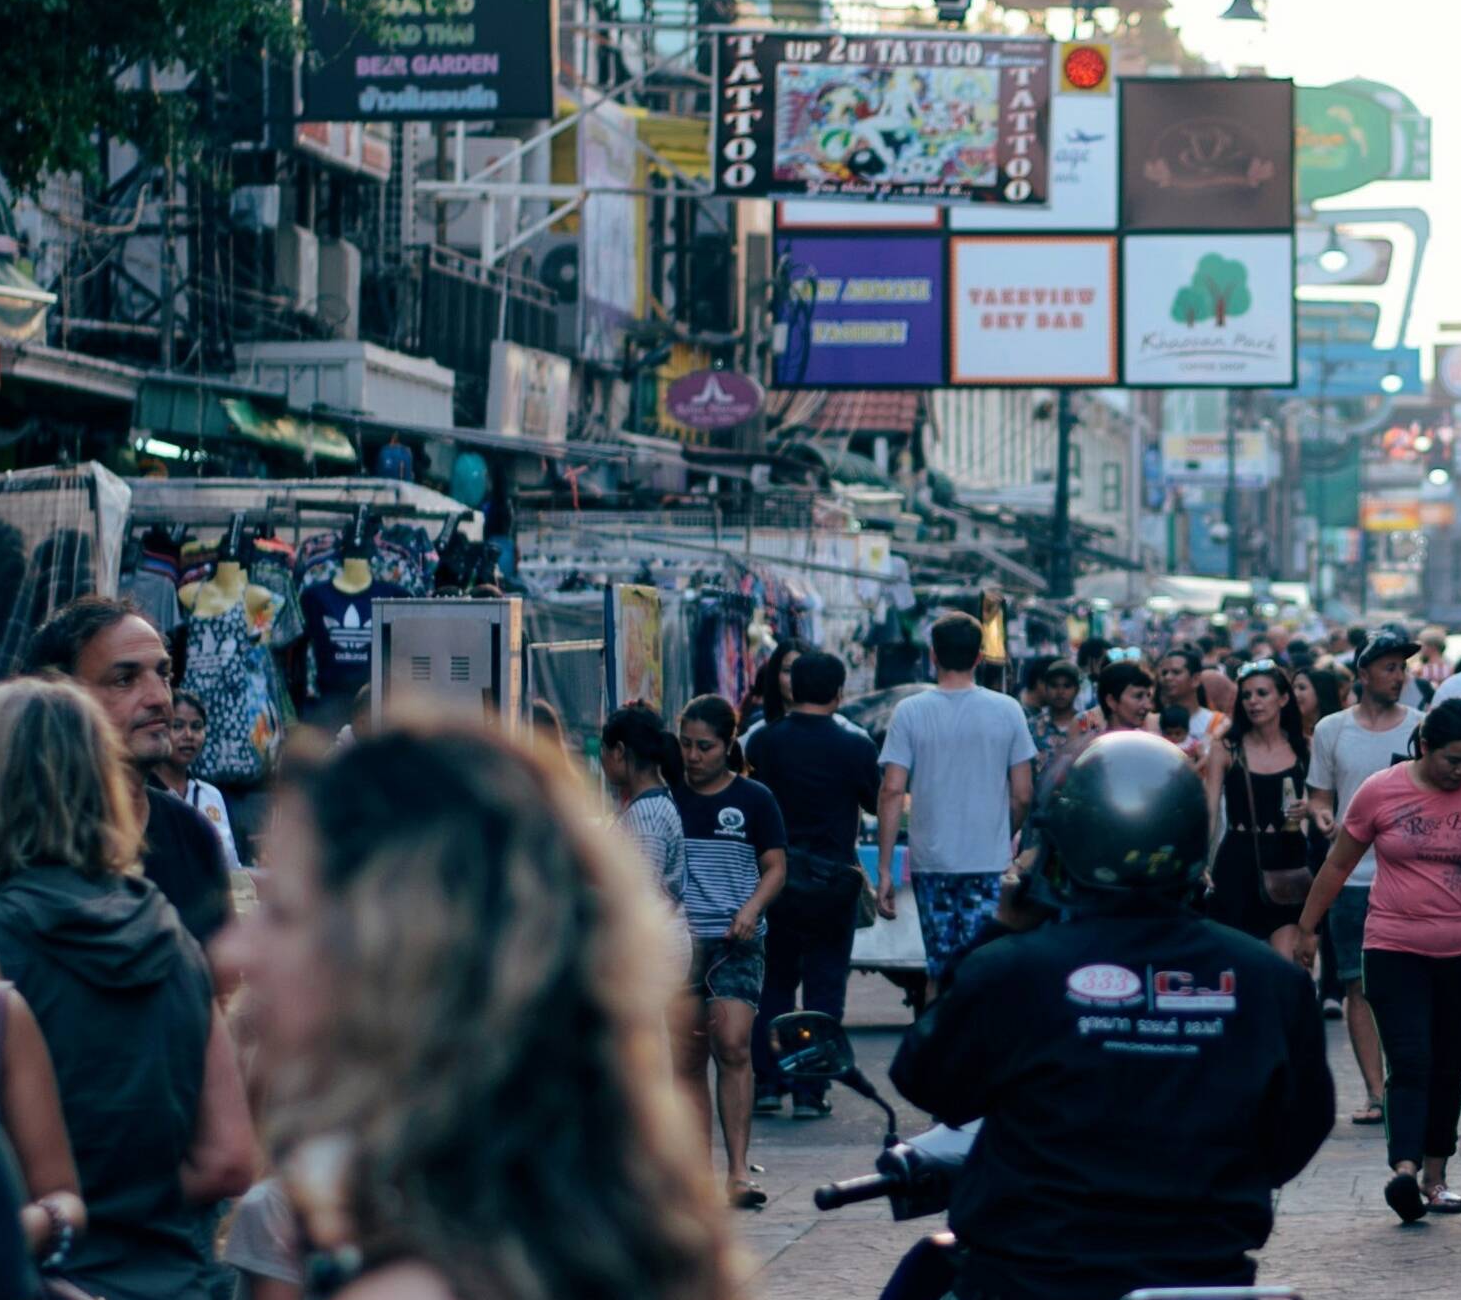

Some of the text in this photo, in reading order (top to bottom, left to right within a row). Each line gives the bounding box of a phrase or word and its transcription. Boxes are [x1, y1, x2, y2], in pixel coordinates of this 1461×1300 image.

[410, 53, 499, 76] GARDEN
[783, 40, 822, 62] UP
[875, 41, 984, 66] TATTOO
[722, 33, 765, 189] TATTOO
[1002, 65, 1039, 201] TATTOO
[1036, 311, 1085, 331] BAR
[1140, 330, 1281, 353] Khaosan Park
[1081, 970, 1236, 996] 333 CJ
